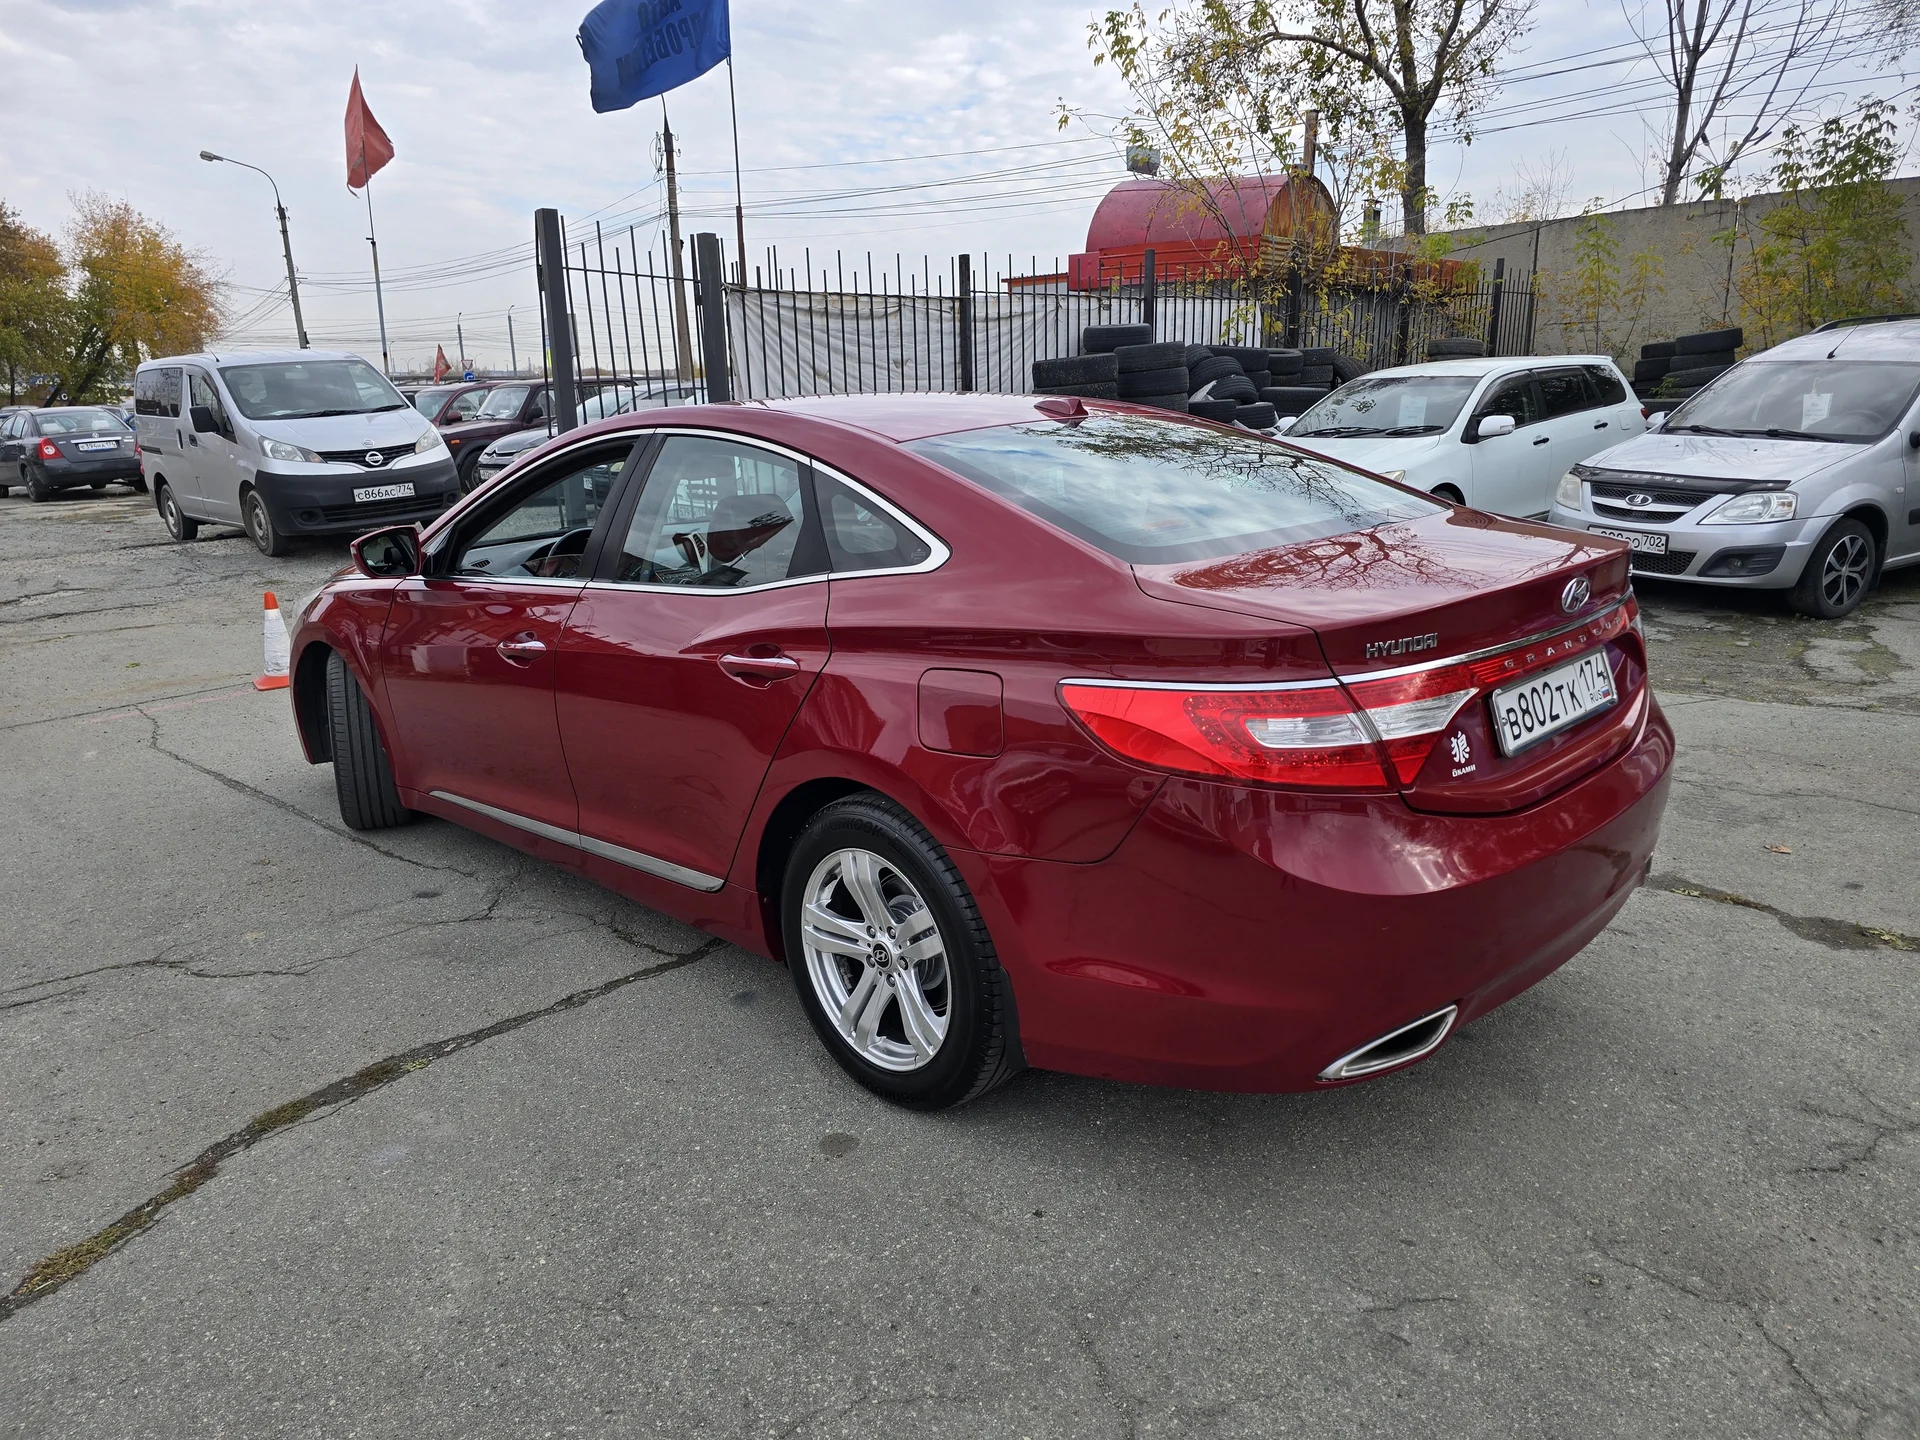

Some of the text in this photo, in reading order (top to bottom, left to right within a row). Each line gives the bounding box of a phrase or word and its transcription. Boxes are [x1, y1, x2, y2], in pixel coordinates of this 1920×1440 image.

[357, 488, 396, 501] С866АС
[397, 484, 413, 493] 774
[1643, 534, 1662, 547] 702
[1366, 632, 1438, 659] HYUNDAI
[1504, 616, 1622, 669] GRANDEUR
[1505, 657, 1608, 741] В802ТК 174
[1589, 689, 1603, 705] RUS
[1450, 730, 1471, 764] 狼
